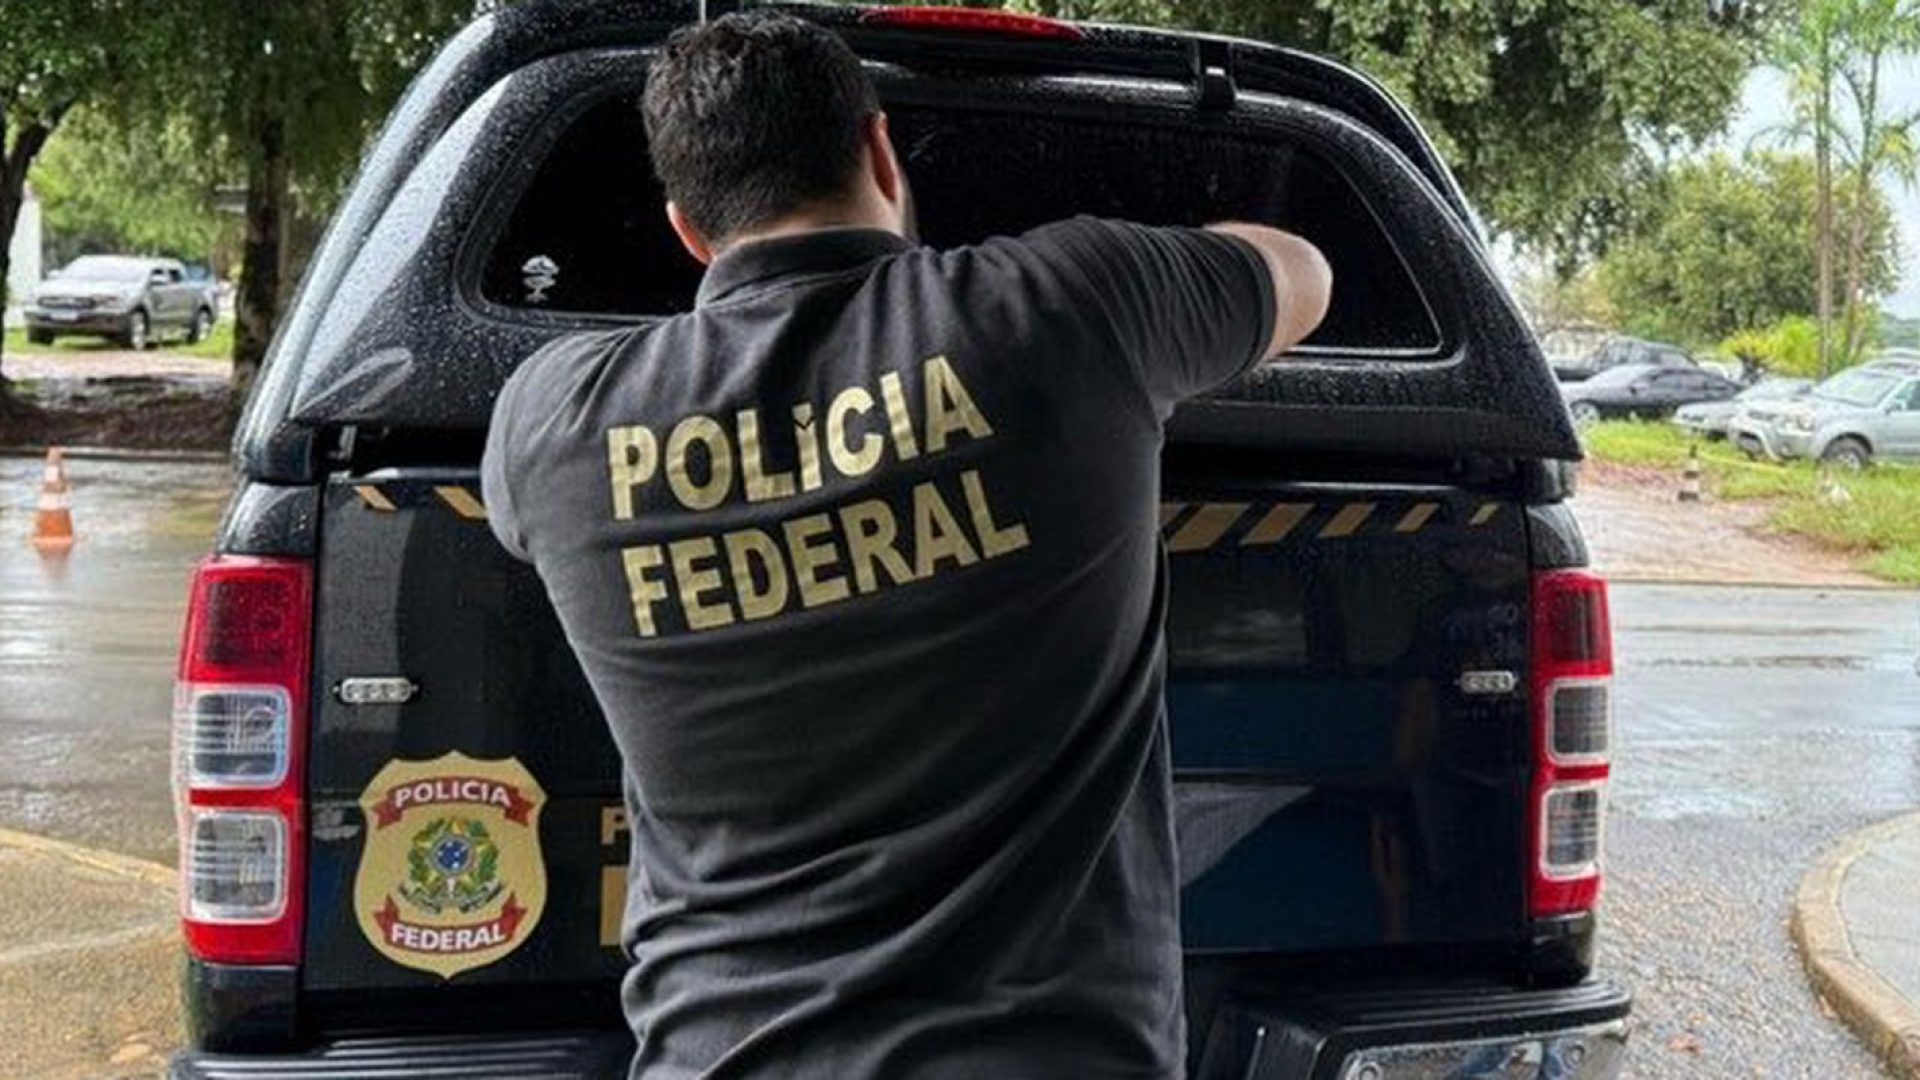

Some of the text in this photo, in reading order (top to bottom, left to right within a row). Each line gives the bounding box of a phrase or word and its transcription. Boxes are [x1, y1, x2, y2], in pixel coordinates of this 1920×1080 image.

[622, 470, 1030, 637] FEDERAL
[395, 780, 512, 807] POLICIA
[391, 922, 506, 950] FEDERAL
